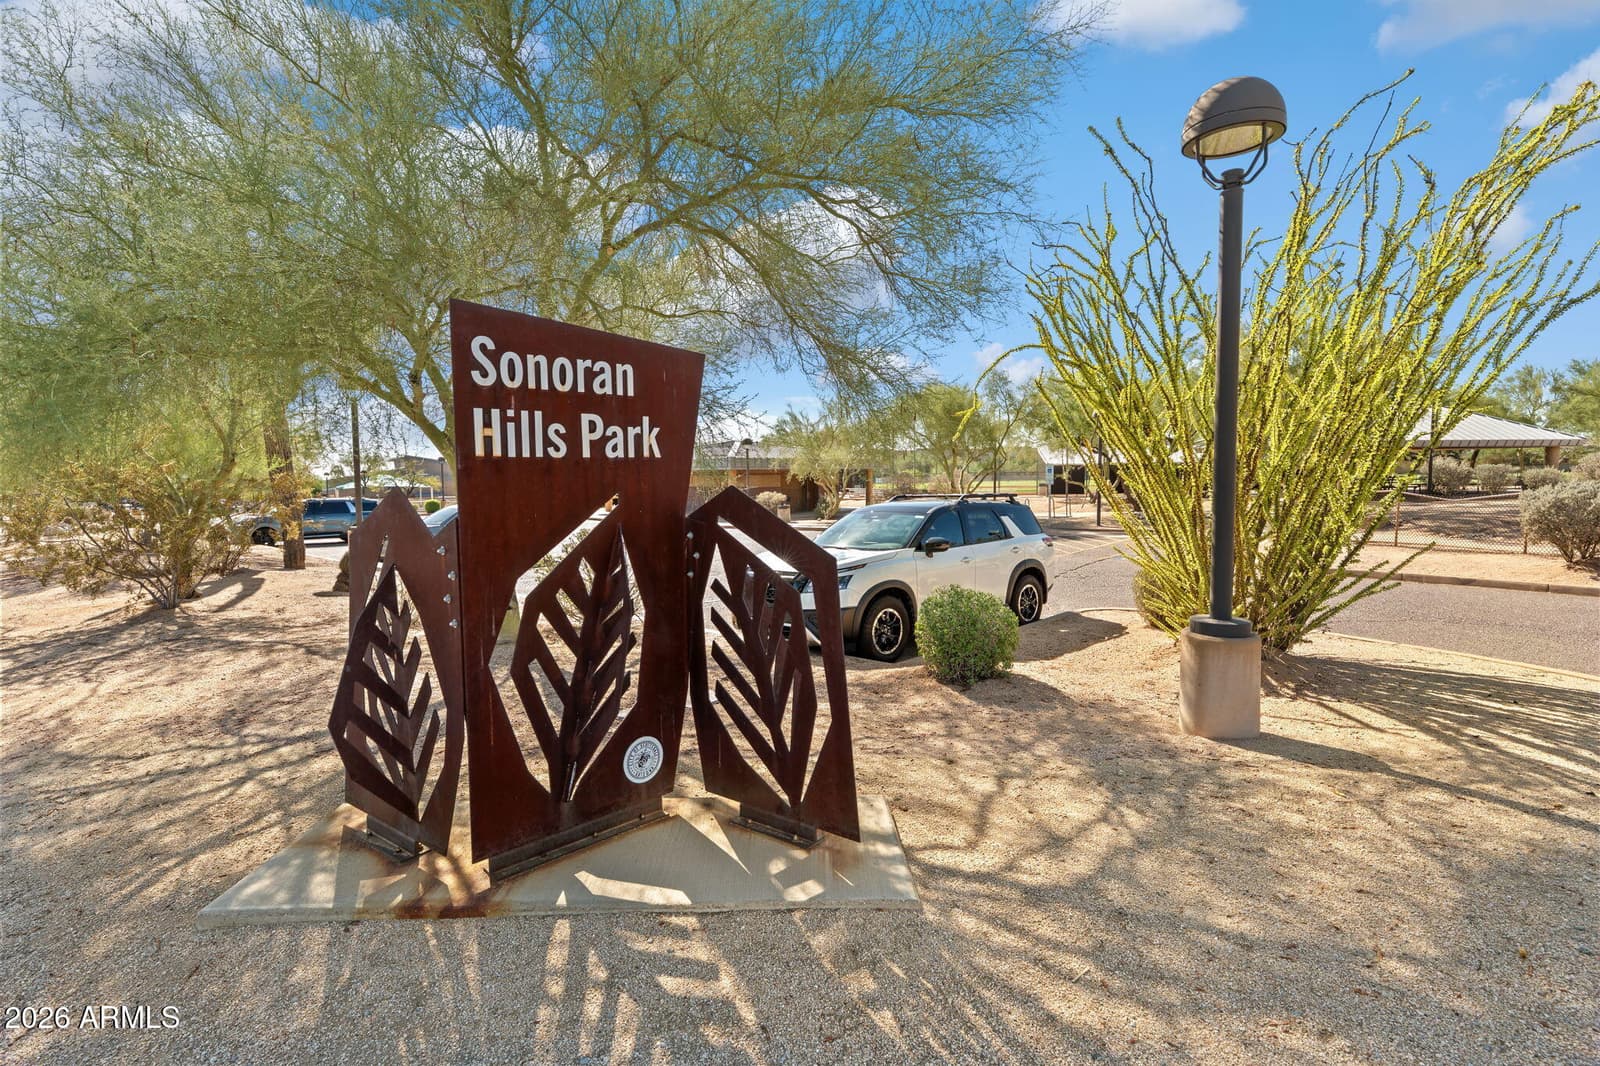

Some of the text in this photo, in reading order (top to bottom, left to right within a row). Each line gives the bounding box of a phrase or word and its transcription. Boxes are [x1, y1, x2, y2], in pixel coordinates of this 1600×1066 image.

[470, 335, 635, 397] Sonoran
[473, 407, 662, 458] Hills Park
